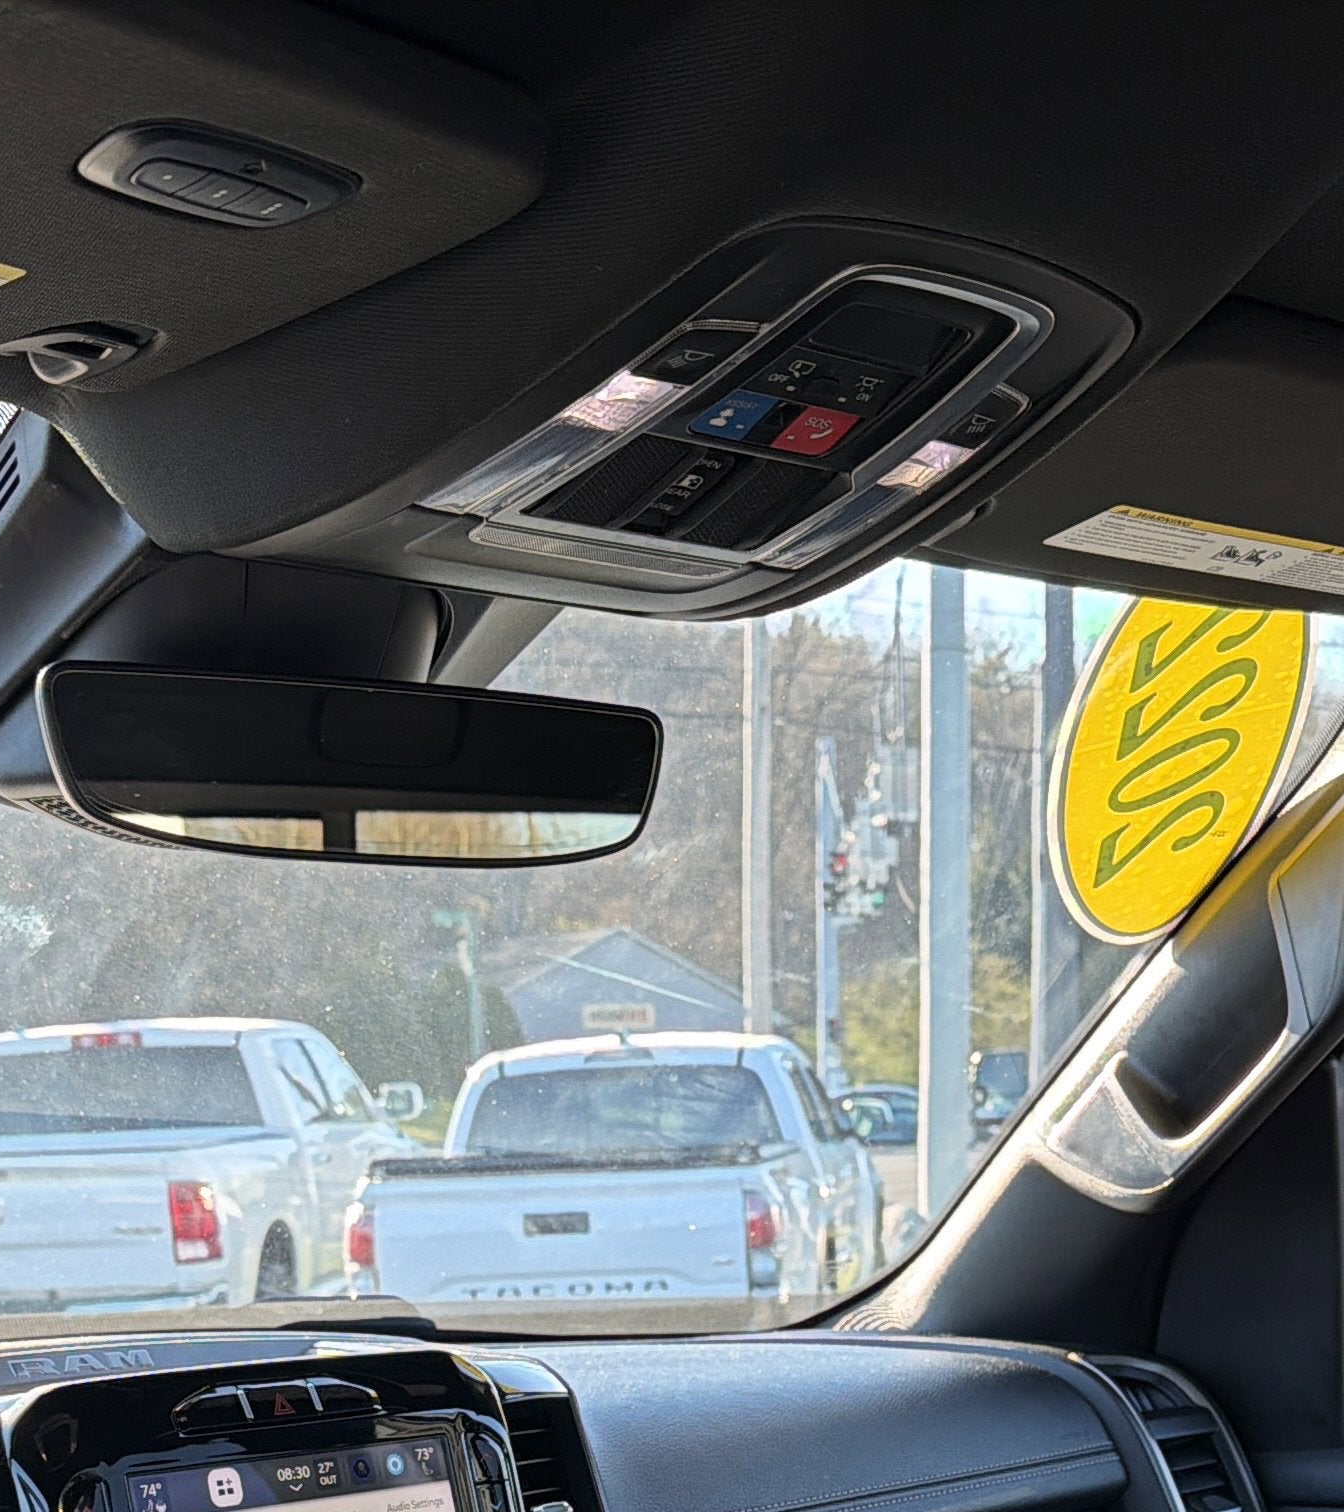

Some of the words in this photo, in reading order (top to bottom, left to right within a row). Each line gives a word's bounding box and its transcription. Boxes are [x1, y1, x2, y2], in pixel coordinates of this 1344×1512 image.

[768, 372, 790, 383] OFF
[805, 417, 833, 430] SOS
[462, 1279, 669, 1299] TACOMA
[7, 1348, 156, 1379] RAM
[276, 1464, 312, 1482] 08:30
[319, 1474, 338, 1487] OUT
[410, 1496, 445, 1512] Settings
